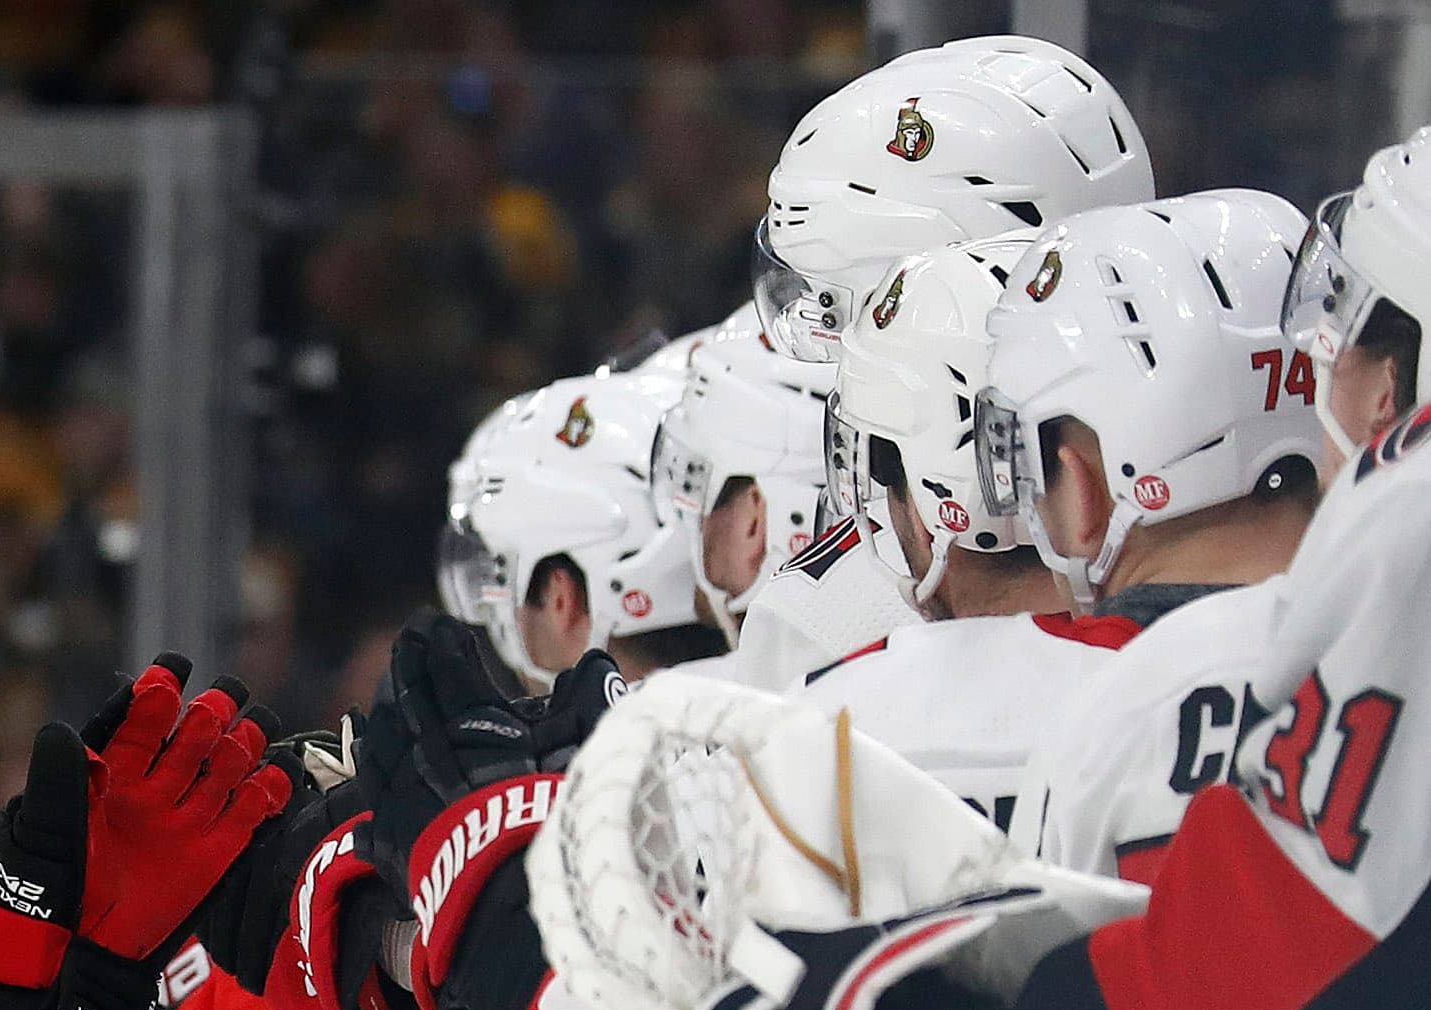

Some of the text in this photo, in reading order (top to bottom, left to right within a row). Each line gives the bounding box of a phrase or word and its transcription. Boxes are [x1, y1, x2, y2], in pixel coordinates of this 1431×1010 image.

[1251, 347, 1316, 412] 74
[1135, 480, 1165, 500] MF
[939, 505, 968, 526] MF
